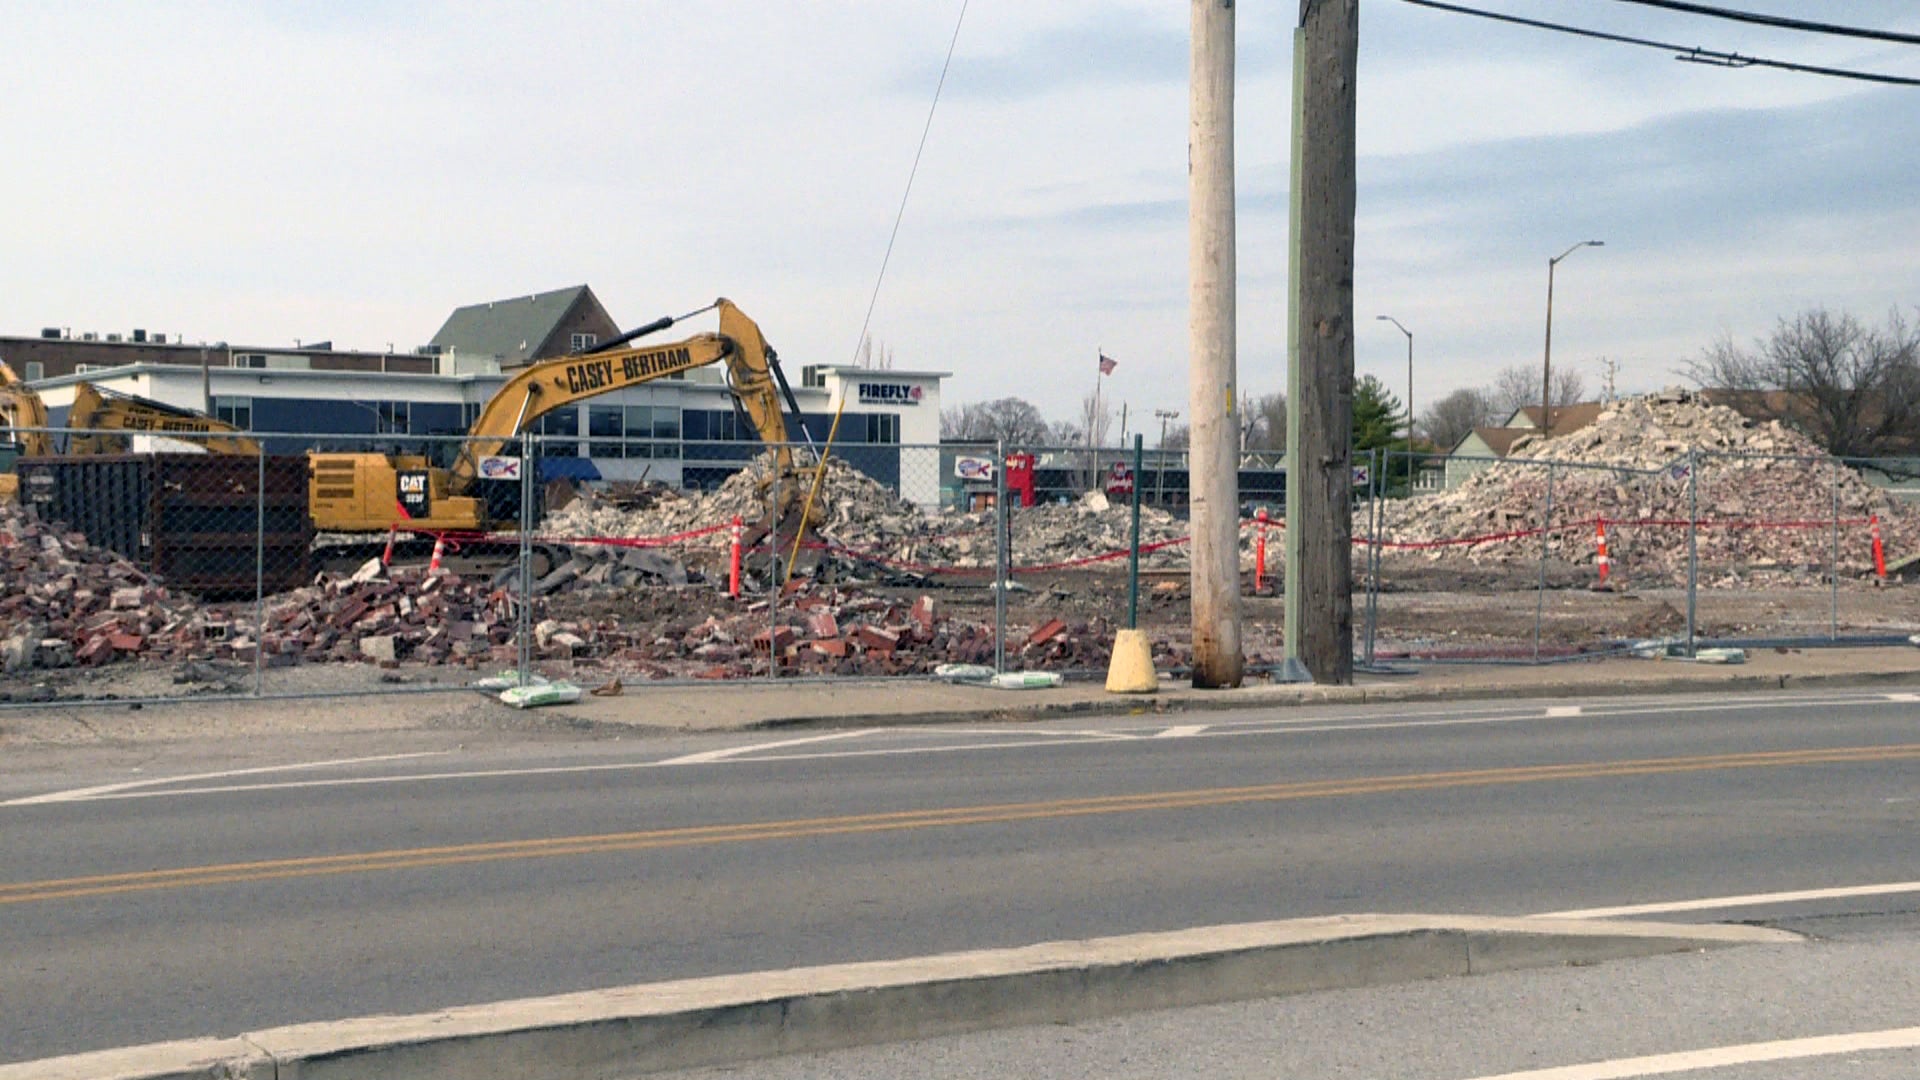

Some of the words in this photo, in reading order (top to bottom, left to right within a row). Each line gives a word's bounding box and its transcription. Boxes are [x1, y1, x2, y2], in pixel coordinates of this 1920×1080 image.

[567, 348, 691, 394] CASEY-BERTRAM
[859, 384, 910, 398] FIREFLY
[400, 475, 425, 492] CAT
